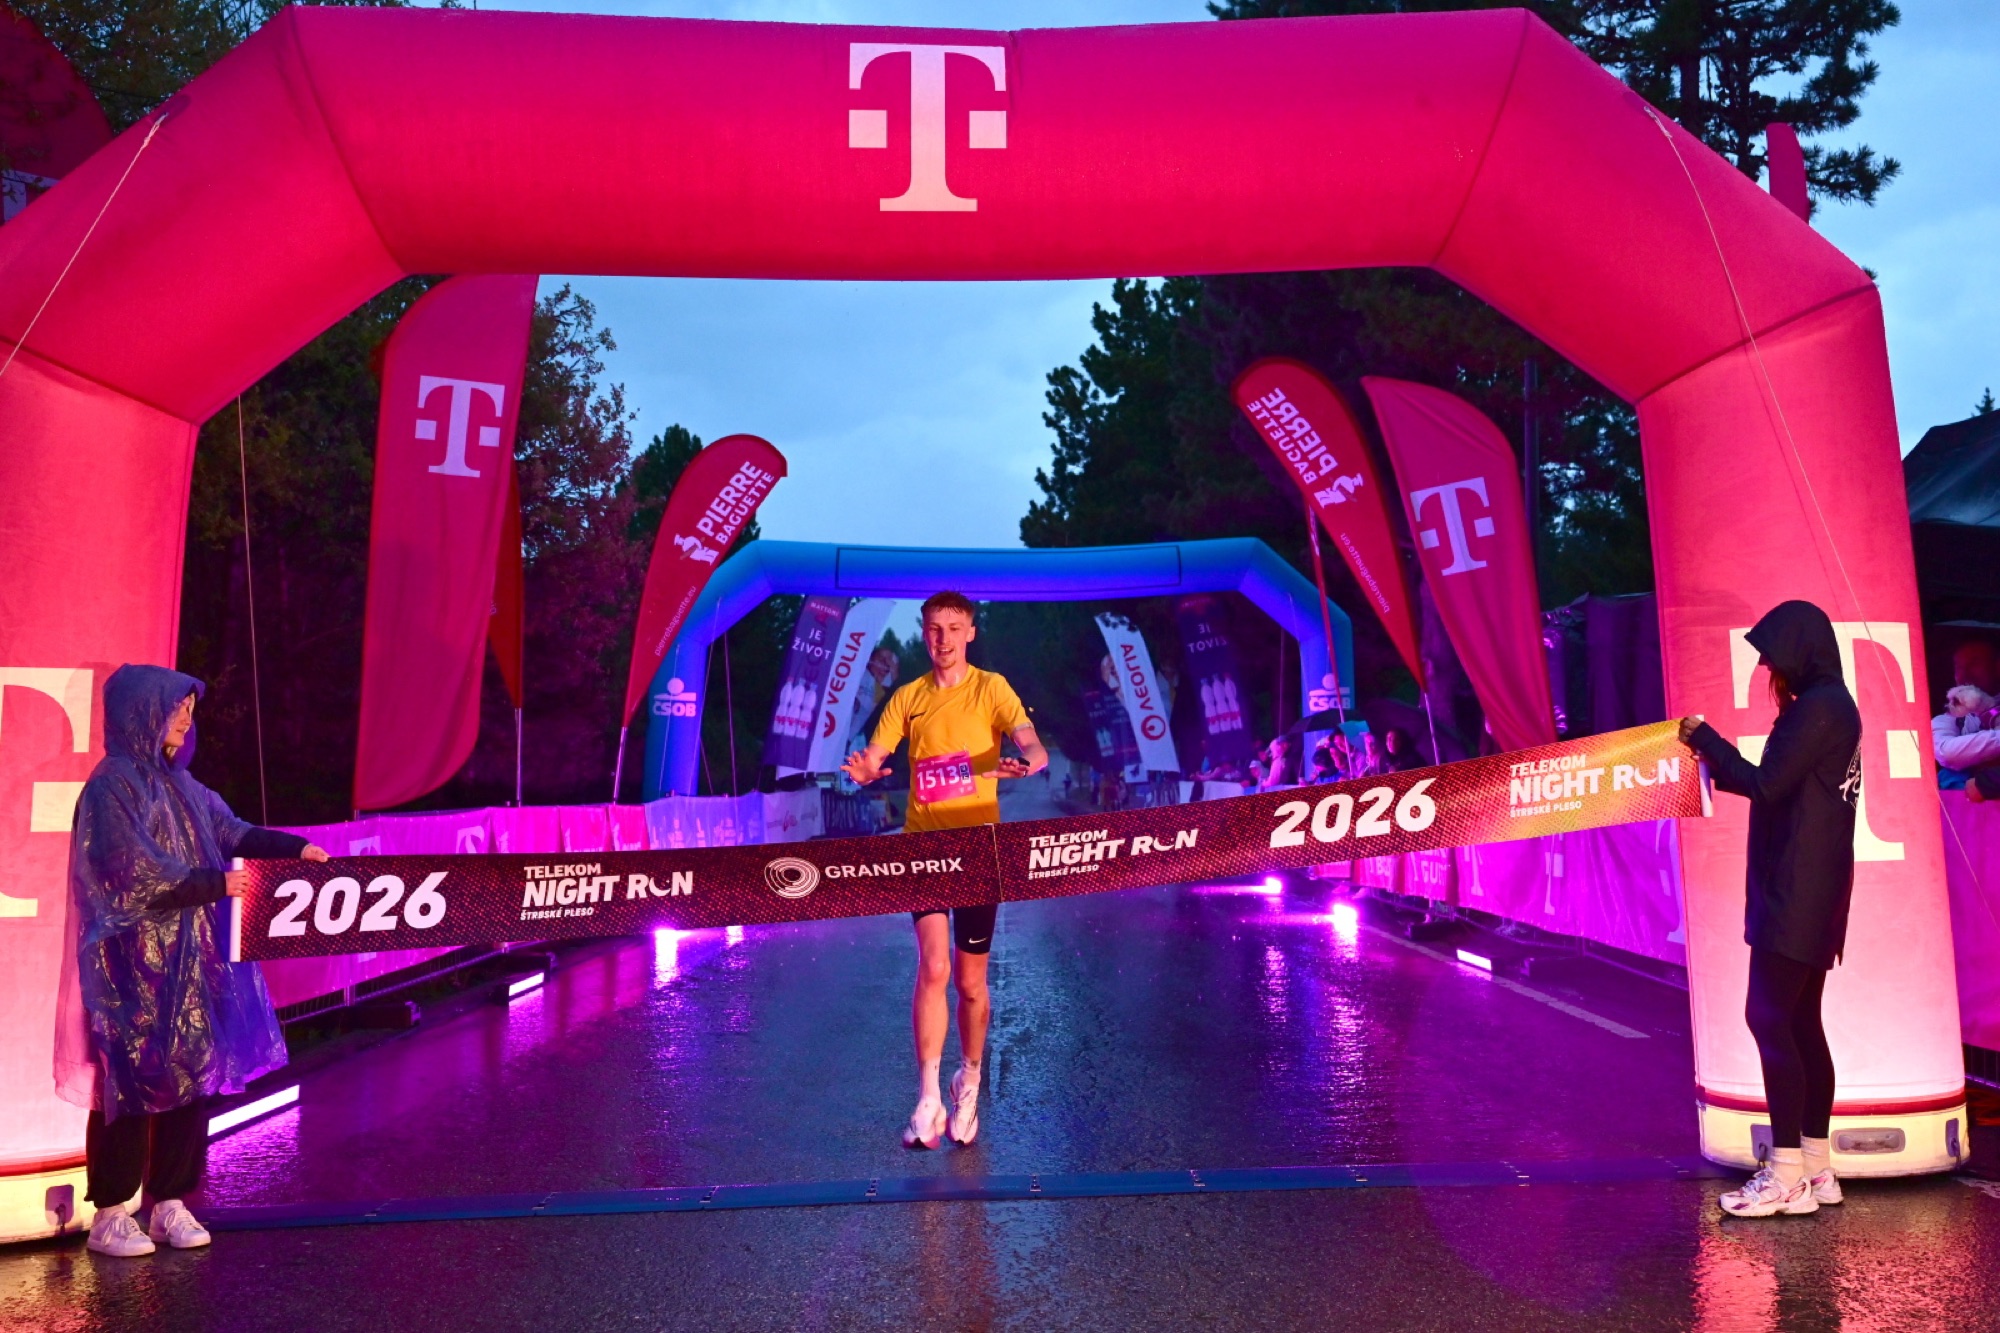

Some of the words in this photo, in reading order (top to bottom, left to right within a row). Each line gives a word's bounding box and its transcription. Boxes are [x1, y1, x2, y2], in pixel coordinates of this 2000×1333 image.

[848, 42, 1008, 213] T
[414, 374, 505, 478] T
[696, 460, 763, 534] PIERRE
[715, 471, 775, 546] BAGUETTE
[1410, 476, 1496, 577] T
[792, 636, 832, 660] ŽIVOT
[808, 627, 822, 641] JE
[827, 630, 867, 706] VEOLIA
[1510, 754, 1587, 778] TELEKOM
[1510, 769, 1605, 805] NIGHT
[1270, 778, 1437, 849] 2026
[1553, 800, 1582, 812] PLESO
[1029, 829, 1108, 846] TELEKOM
[825, 861, 908, 879] GRAND
[911, 857, 964, 874] PRIX
[1028, 839, 1125, 869] NIGHT
[523, 863, 602, 879] TELEKOM
[1028, 866, 1069, 881] ŠTRBSKÉ
[1070, 863, 1099, 875] PLESO
[268, 871, 450, 938] 2026
[522, 875, 620, 908] NIGHT
[520, 905, 563, 921] ŠTRBSKÉ
[564, 906, 594, 918] PLESO
